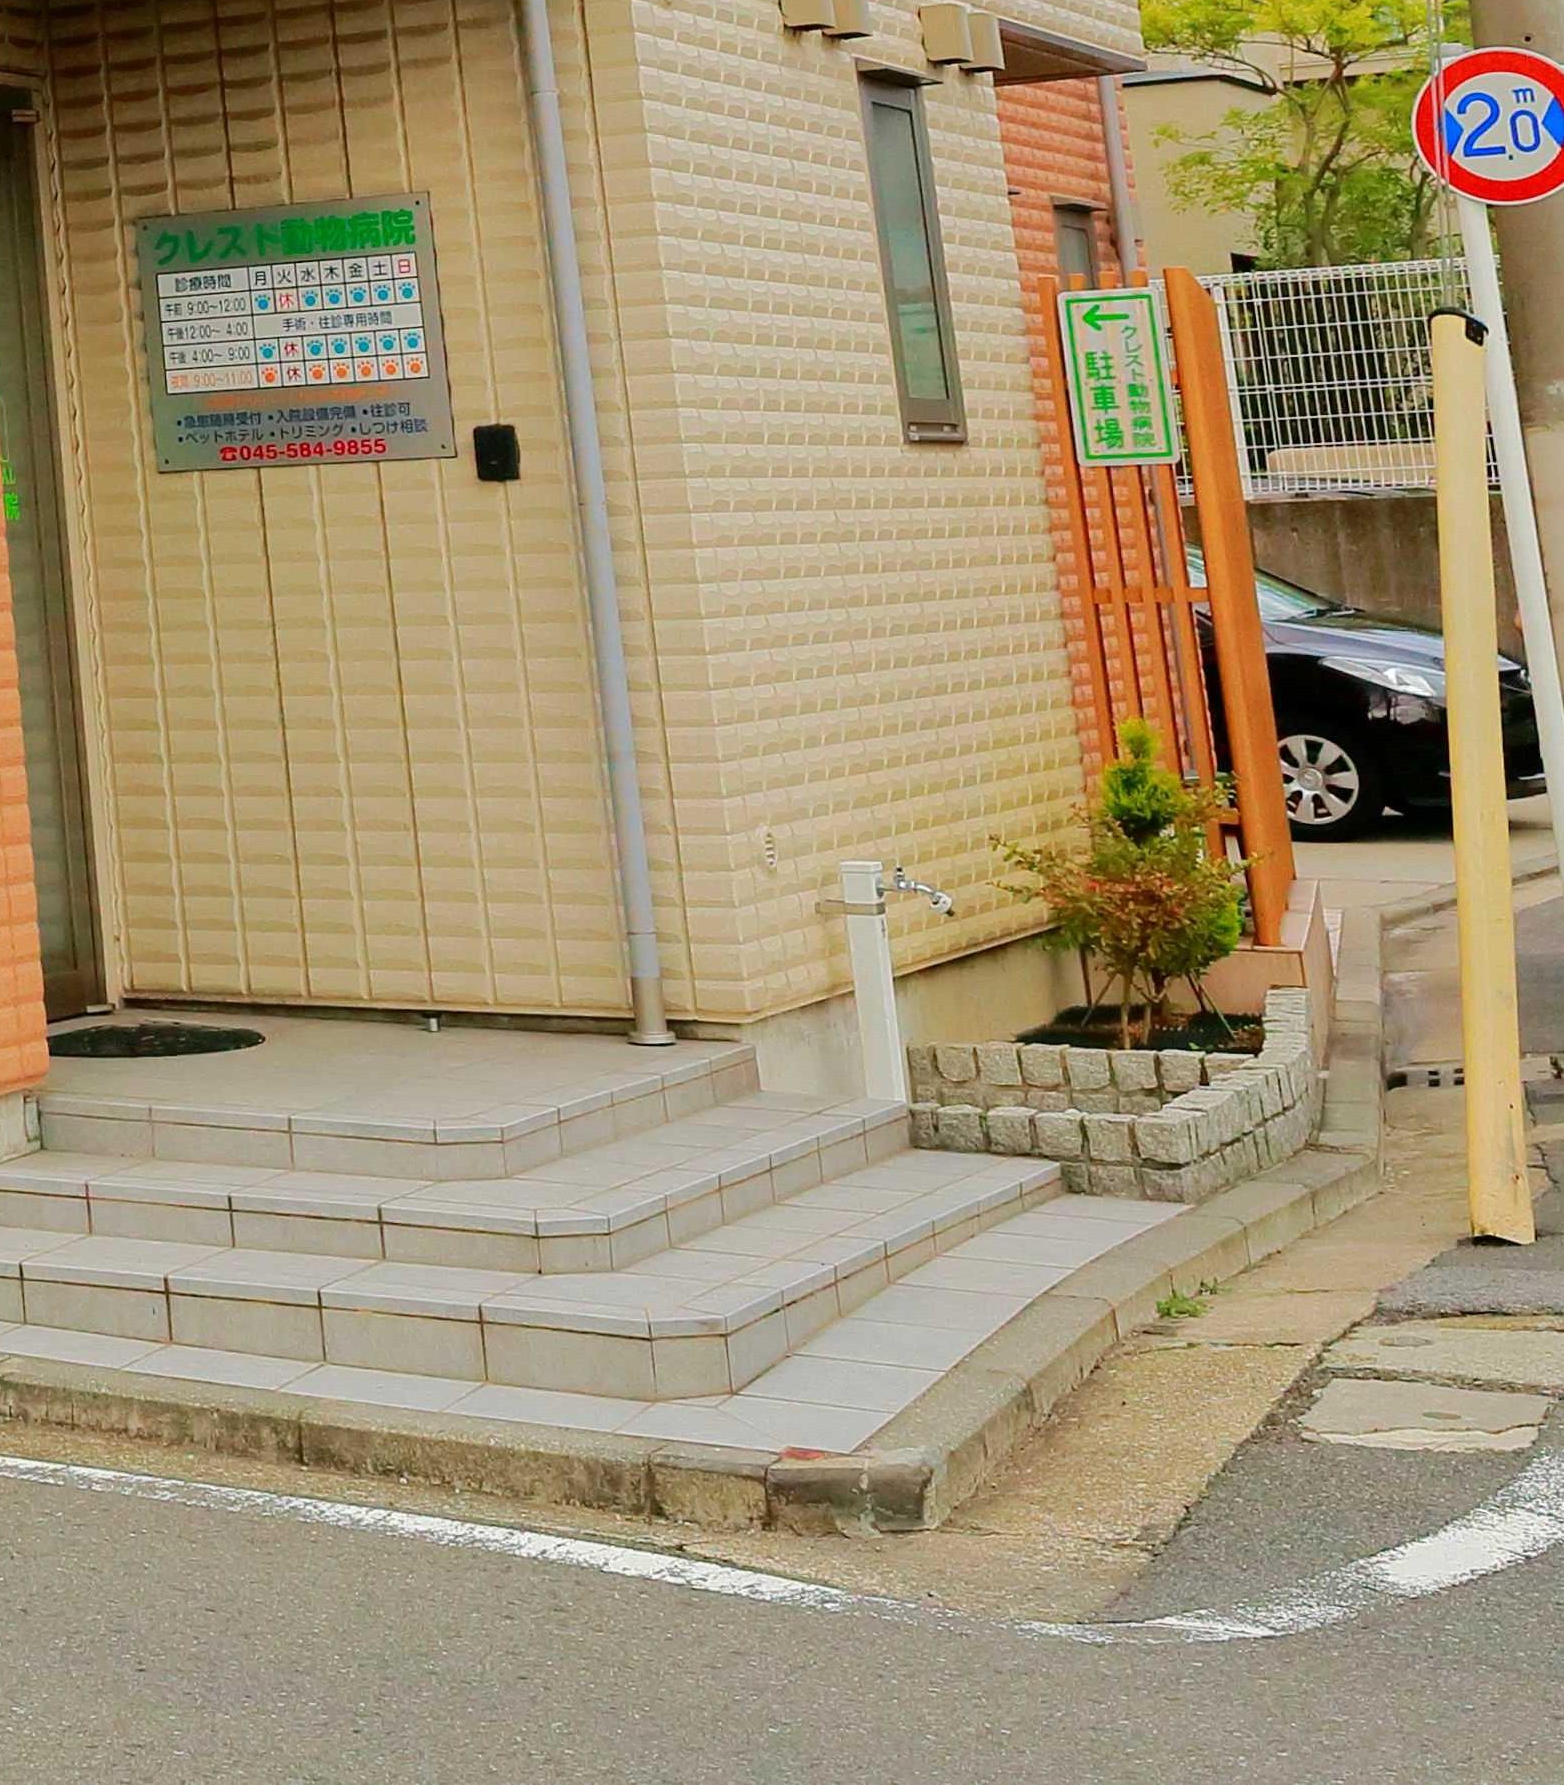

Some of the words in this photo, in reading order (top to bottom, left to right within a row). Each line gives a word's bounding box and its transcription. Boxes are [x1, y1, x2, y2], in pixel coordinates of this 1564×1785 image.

[154, 208, 416, 266] クレスト動物病院
[175, 274, 232, 293] 診療時間
[254, 271, 267, 287] 月
[277, 268, 292, 284] 火
[300, 267, 316, 283] 水
[324, 265, 339, 280] 木
[348, 262, 363, 278] 金
[373, 261, 388, 277] 土
[398, 258, 411, 274] 日
[279, 293, 294, 309] 休
[284, 342, 298, 357] 休
[287, 366, 301, 382] 休
[1121, 325, 1156, 448] クレスト動物病院
[1084, 350, 1124, 450] 駐車場
[239, 438, 387, 462] 045-584-9855
